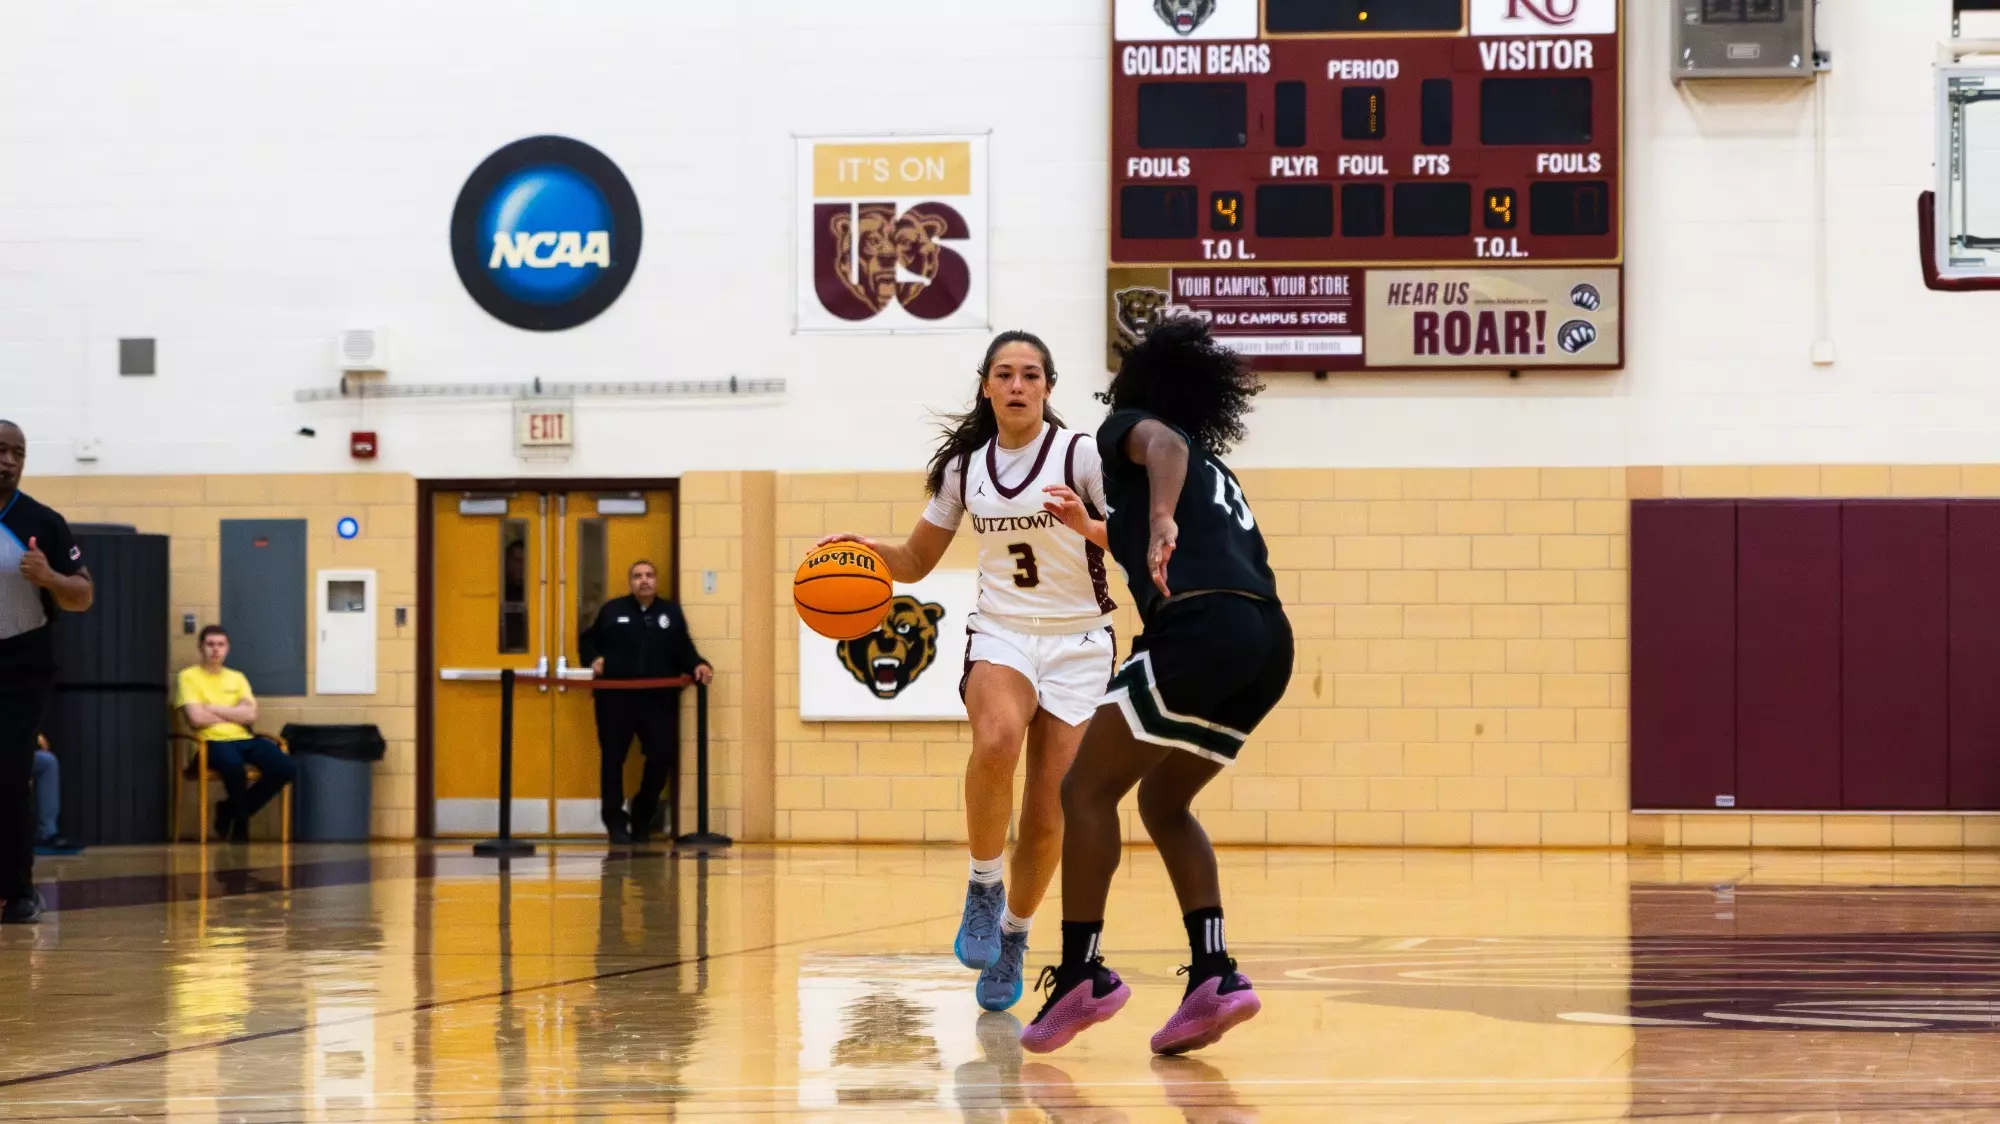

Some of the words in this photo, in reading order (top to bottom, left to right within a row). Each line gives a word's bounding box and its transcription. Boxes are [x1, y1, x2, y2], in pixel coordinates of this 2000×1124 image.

[1123, 45, 1201, 75] GOLDEN
[1206, 44, 1271, 74] BEARS
[1479, 40, 1594, 71] VISITOR
[1327, 58, 1400, 80] PERIOD
[837, 157, 890, 183] IT'S
[899, 155, 945, 182] ON
[1127, 156, 1191, 178] FOULS
[1270, 155, 1318, 177] PLYR
[1338, 154, 1389, 176] FOUL
[1412, 153, 1450, 175] PTS
[1536, 152, 1602, 174] FOULS
[1216, 198, 1237, 225] 4
[1490, 195, 1511, 223] 4
[488, 231, 611, 269] NCAA
[1474, 236, 1529, 258] T.O.L.
[813, 201, 971, 322] US
[1178, 276, 1210, 297] YOUR
[1215, 276, 1270, 298] CAMPUS,
[1272, 276, 1307, 296] YOUR
[1310, 275, 1350, 296] STORE
[1388, 282, 1439, 306] HEAR
[1443, 282, 1470, 305] US
[1216, 313, 1237, 325] KU
[1239, 312, 1298, 325] CAMPUS
[1301, 312, 1348, 324] STORE
[1414, 310, 1547, 355] ROAR!
[529, 413, 565, 440] EXIT
[808, 551, 876, 573] Wilson
[1007, 542, 1040, 588] 3
